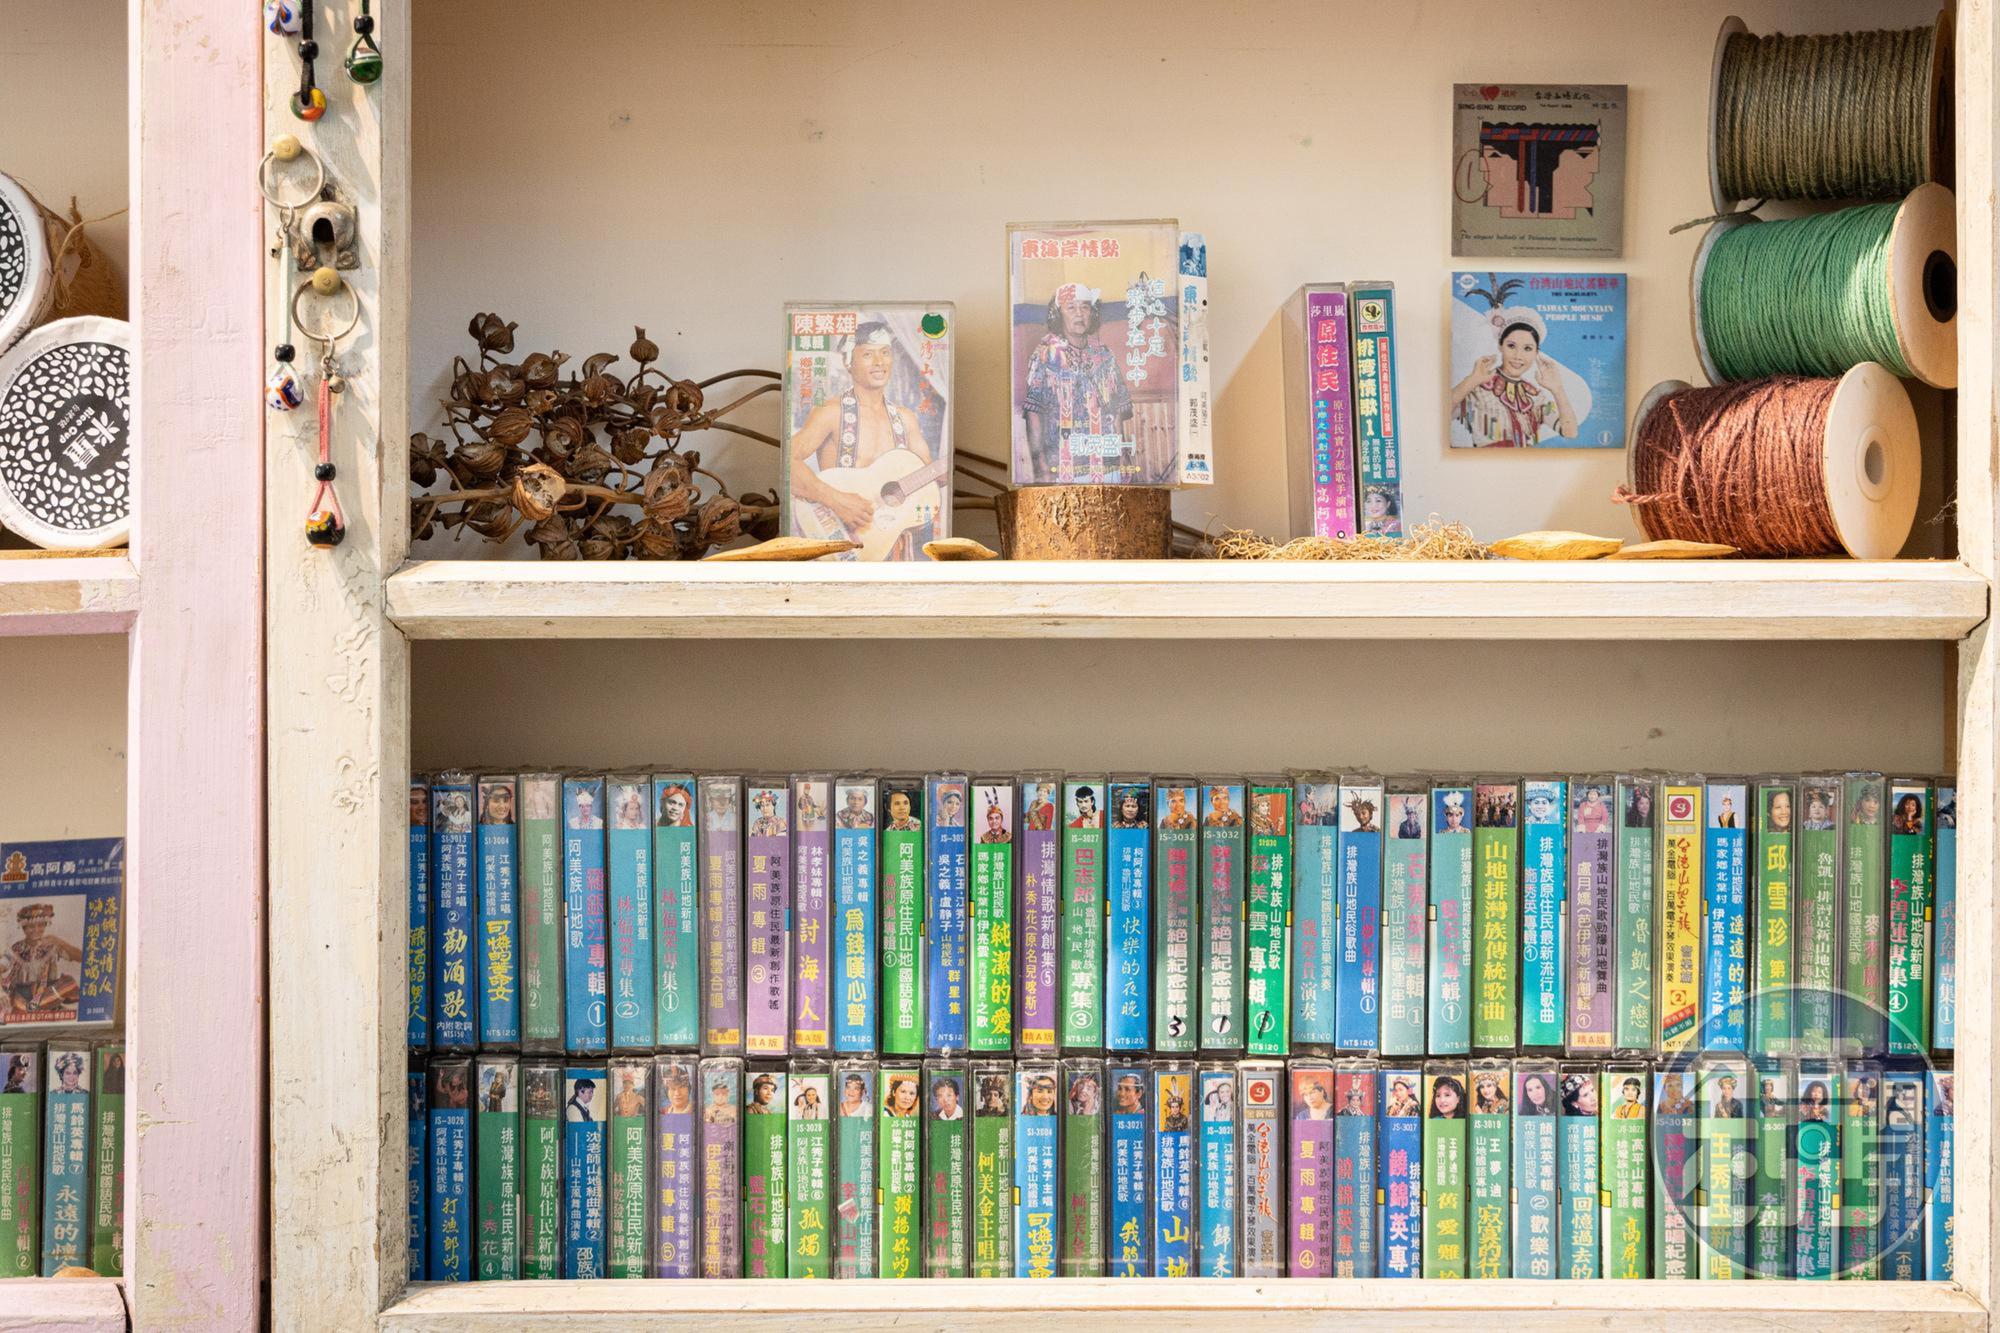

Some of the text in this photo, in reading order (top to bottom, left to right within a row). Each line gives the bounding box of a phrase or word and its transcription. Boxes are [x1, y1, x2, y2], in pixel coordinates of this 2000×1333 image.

[59, 406, 95, 444] Rice Cup
[568, 839, 584, 948] 阿美族山地歌
[1269, 853, 1283, 970] 排灣族山地民歌
[1345, 845, 1358, 963] 排灣族山地民俗歌曲
[1483, 840, 1508, 1021] 山地排灣族傳統歌曲
[1539, 837, 1555, 1024] 排灣族原住民最新流行歌曲
[799, 918, 821, 1022] 討海人
[991, 921, 1011, 1035] 純潔的愛
[1121, 917, 1142, 1018] 快樂的夜晚
[52, 1185, 80, 1272] 永遠的懷
